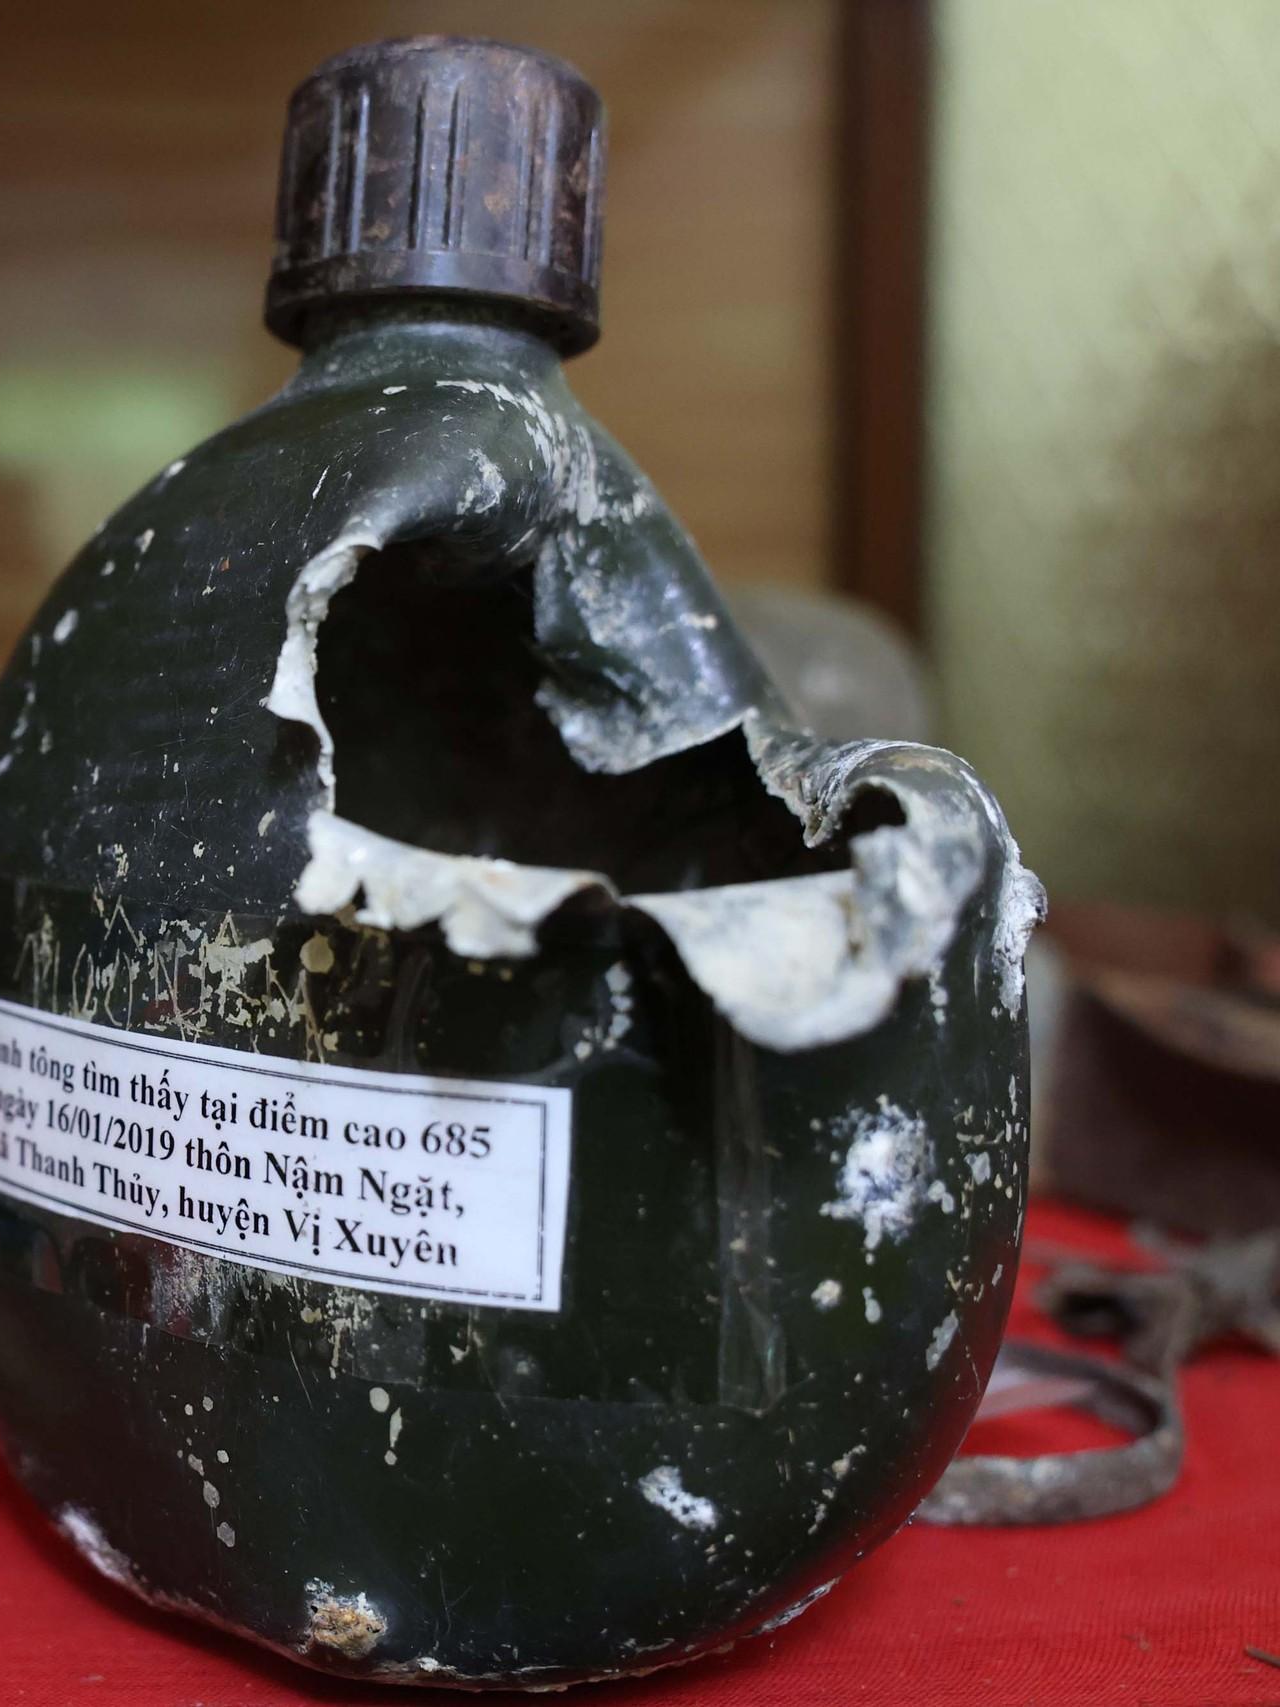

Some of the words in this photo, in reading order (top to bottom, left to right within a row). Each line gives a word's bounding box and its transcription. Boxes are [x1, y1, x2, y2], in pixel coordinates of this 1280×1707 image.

[28, 1046, 76, 1092] tông
[82, 1062, 120, 1098] tìm
[130, 1069, 190, 1120] thấy
[200, 1088, 238, 1130] tại
[249, 1092, 329, 1139] điểm
[344, 1120, 406, 1151] cao
[420, 1120, 492, 1159] 685
[45, 1098, 175, 1160] 16/01/2019
[185, 1136, 251, 1180] thôn
[264, 1151, 344, 1200] Nậm
[358, 1166, 464, 1218] Ngặt,
[15, 1137, 86, 1187] Thanh
[93, 1162, 169, 1219] Thủy,
[178, 1186, 270, 1241] huyện
[283, 1208, 322, 1256] Vị
[333, 1217, 458, 1268] Xuyên
